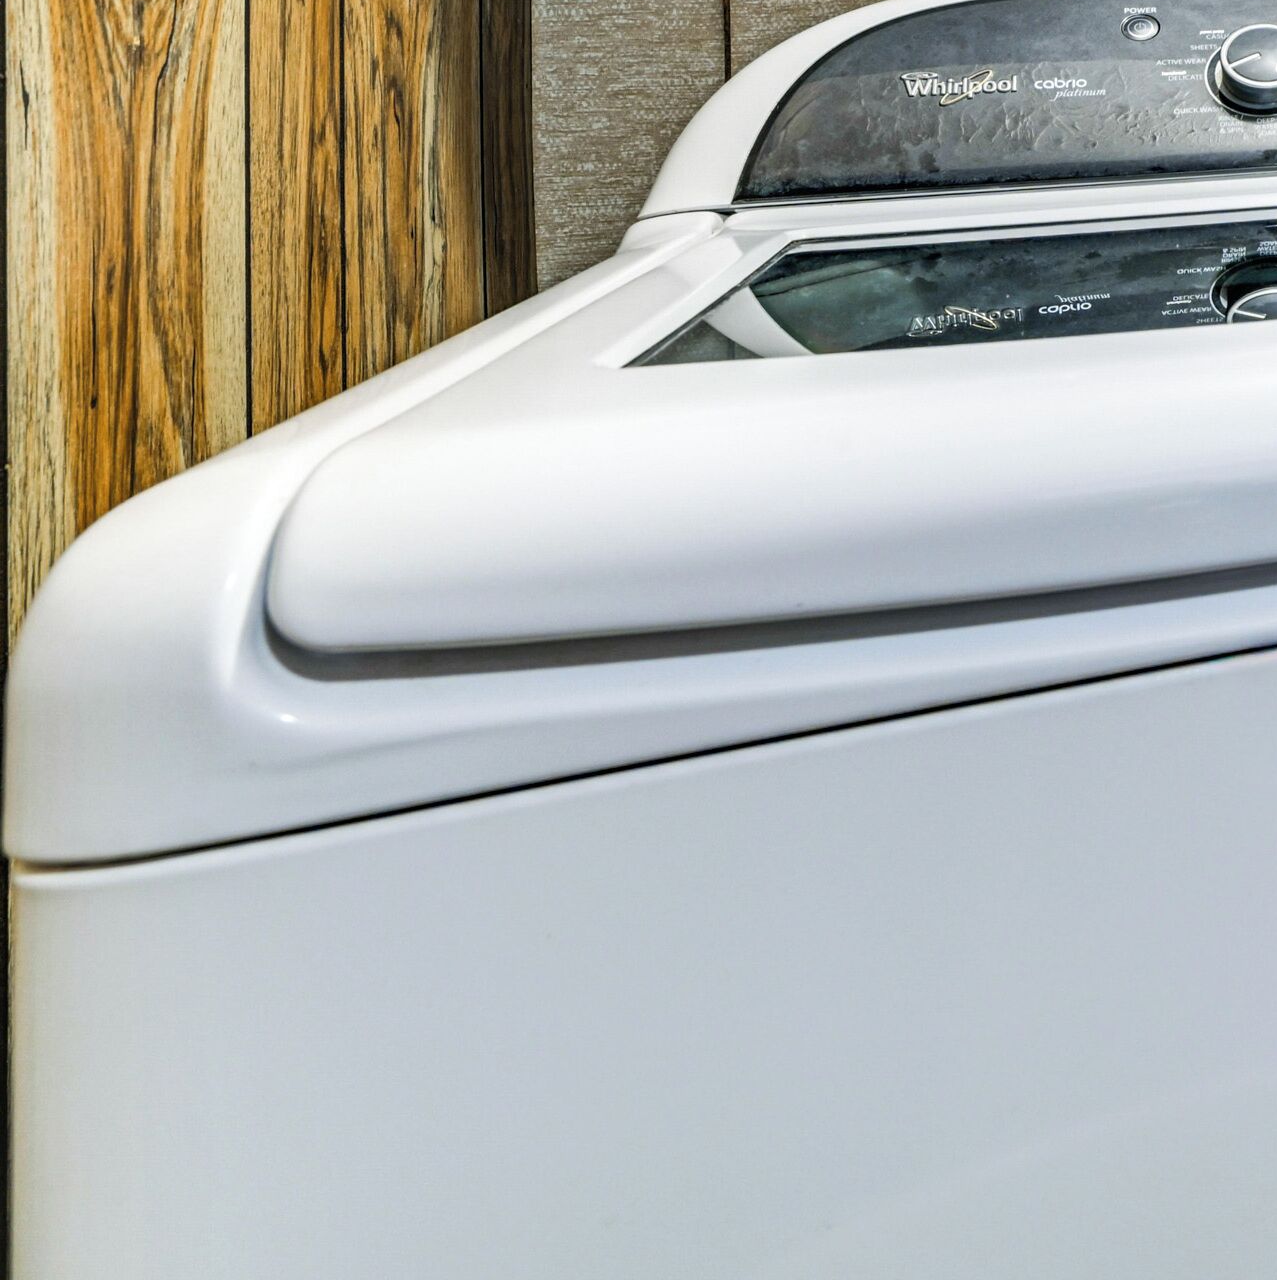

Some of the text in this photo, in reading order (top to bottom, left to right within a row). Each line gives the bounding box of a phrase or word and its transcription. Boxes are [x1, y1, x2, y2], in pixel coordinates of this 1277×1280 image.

[904, 73, 1018, 100] Whirlpool
[1034, 78, 1088, 90] cabrio
[1054, 88, 1106, 100] platinum
[1174, 108, 1199, 116] QUICK
